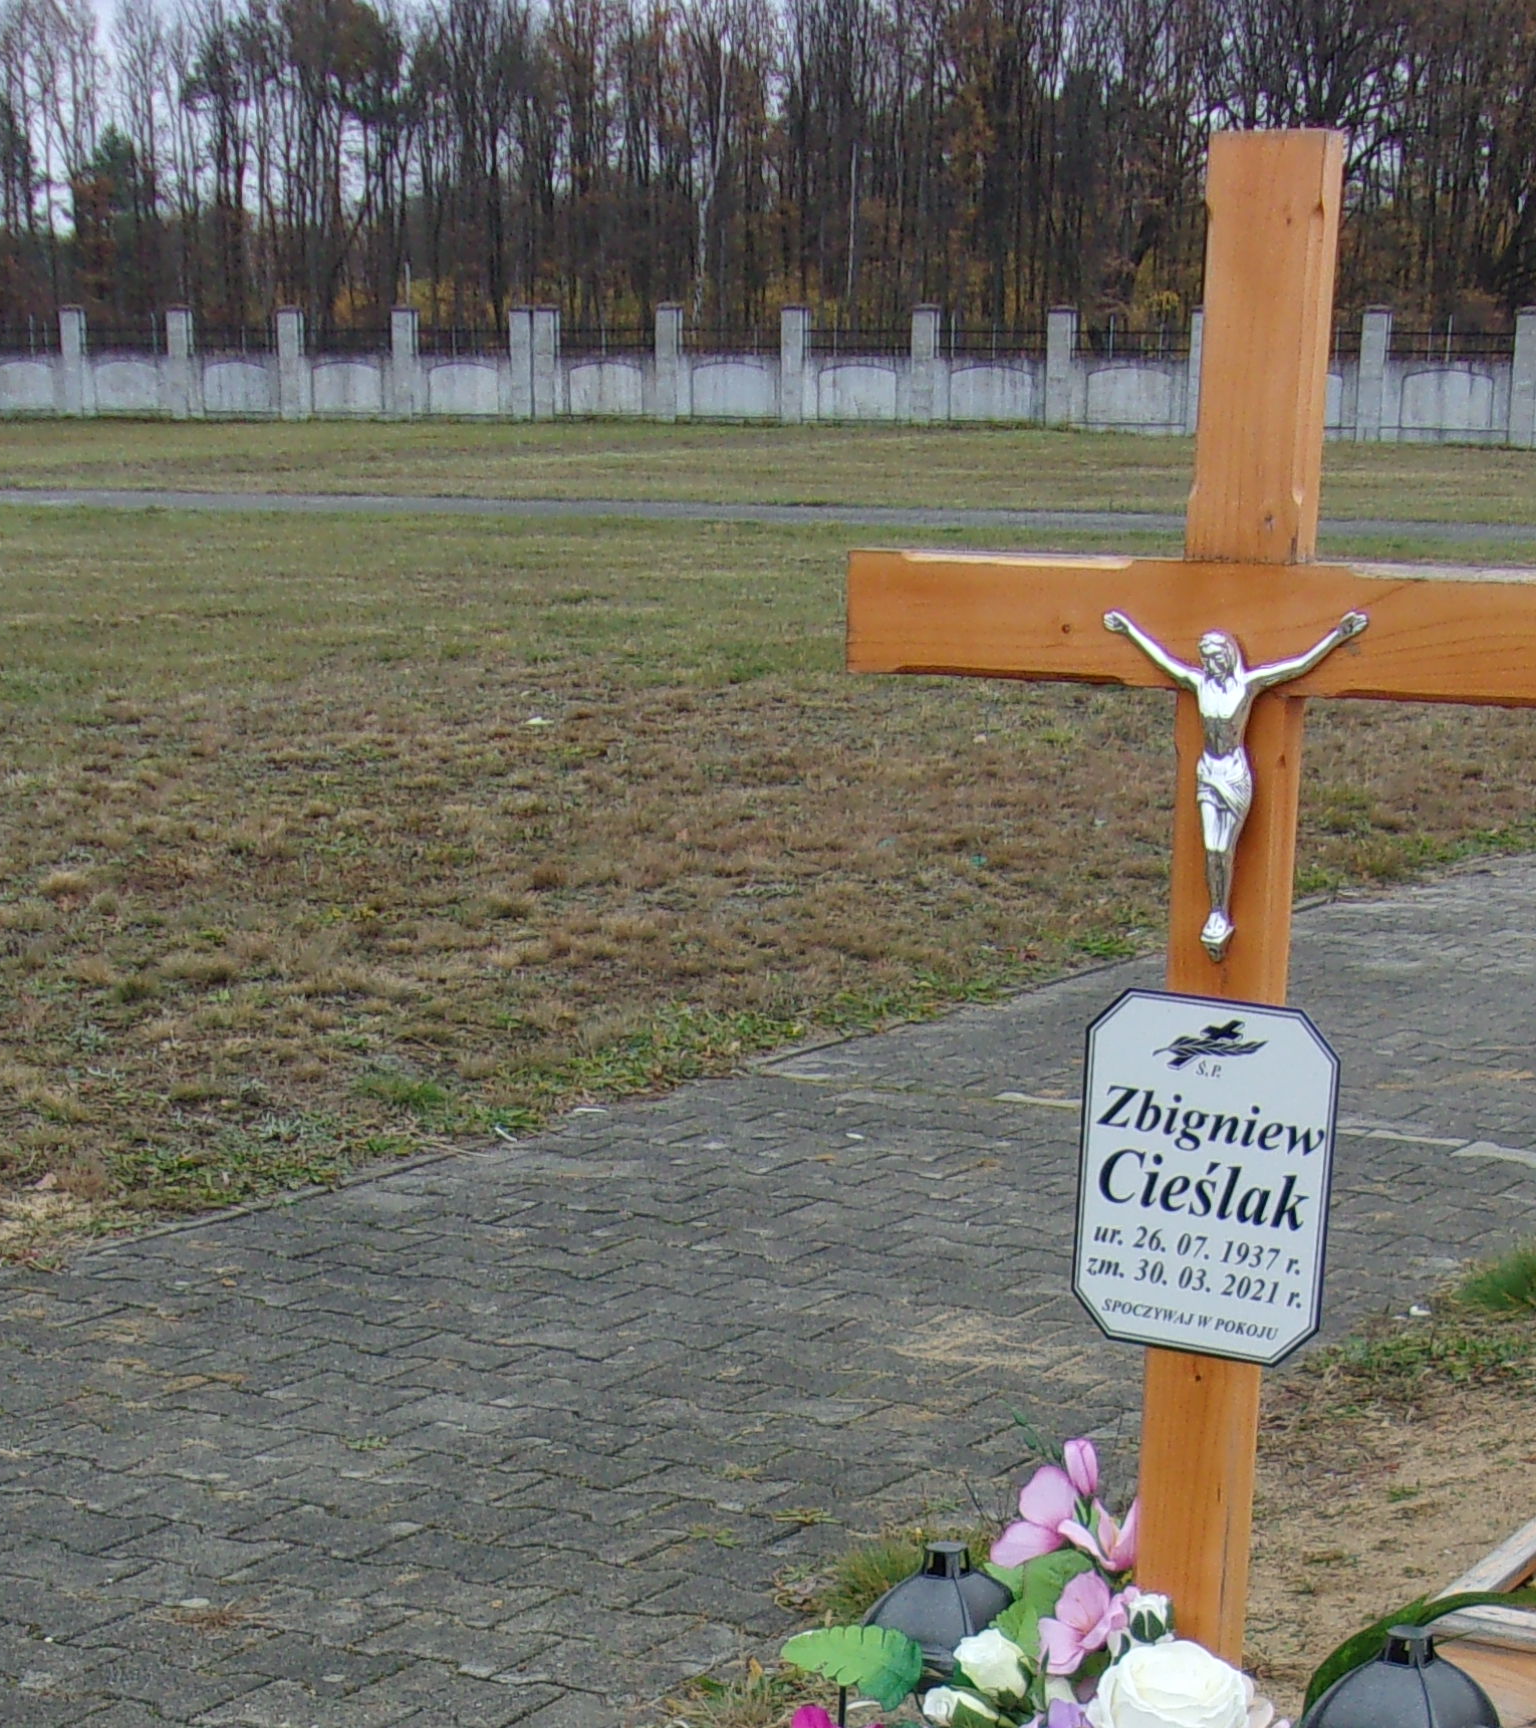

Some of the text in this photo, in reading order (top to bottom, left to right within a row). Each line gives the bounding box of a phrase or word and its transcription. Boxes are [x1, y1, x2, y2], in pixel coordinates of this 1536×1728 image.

[1096, 1084, 1325, 1156] Zbigniew
[1099, 1148, 1310, 1231] Cieślak
[1093, 1225, 1301, 1275] ur. 26. 07. 1937 r.
[1086, 1257, 1302, 1308] zm. 30. 03. 2021 r.
[1101, 1298, 1279, 1341] SPOCZYWAJ W POKOJU
